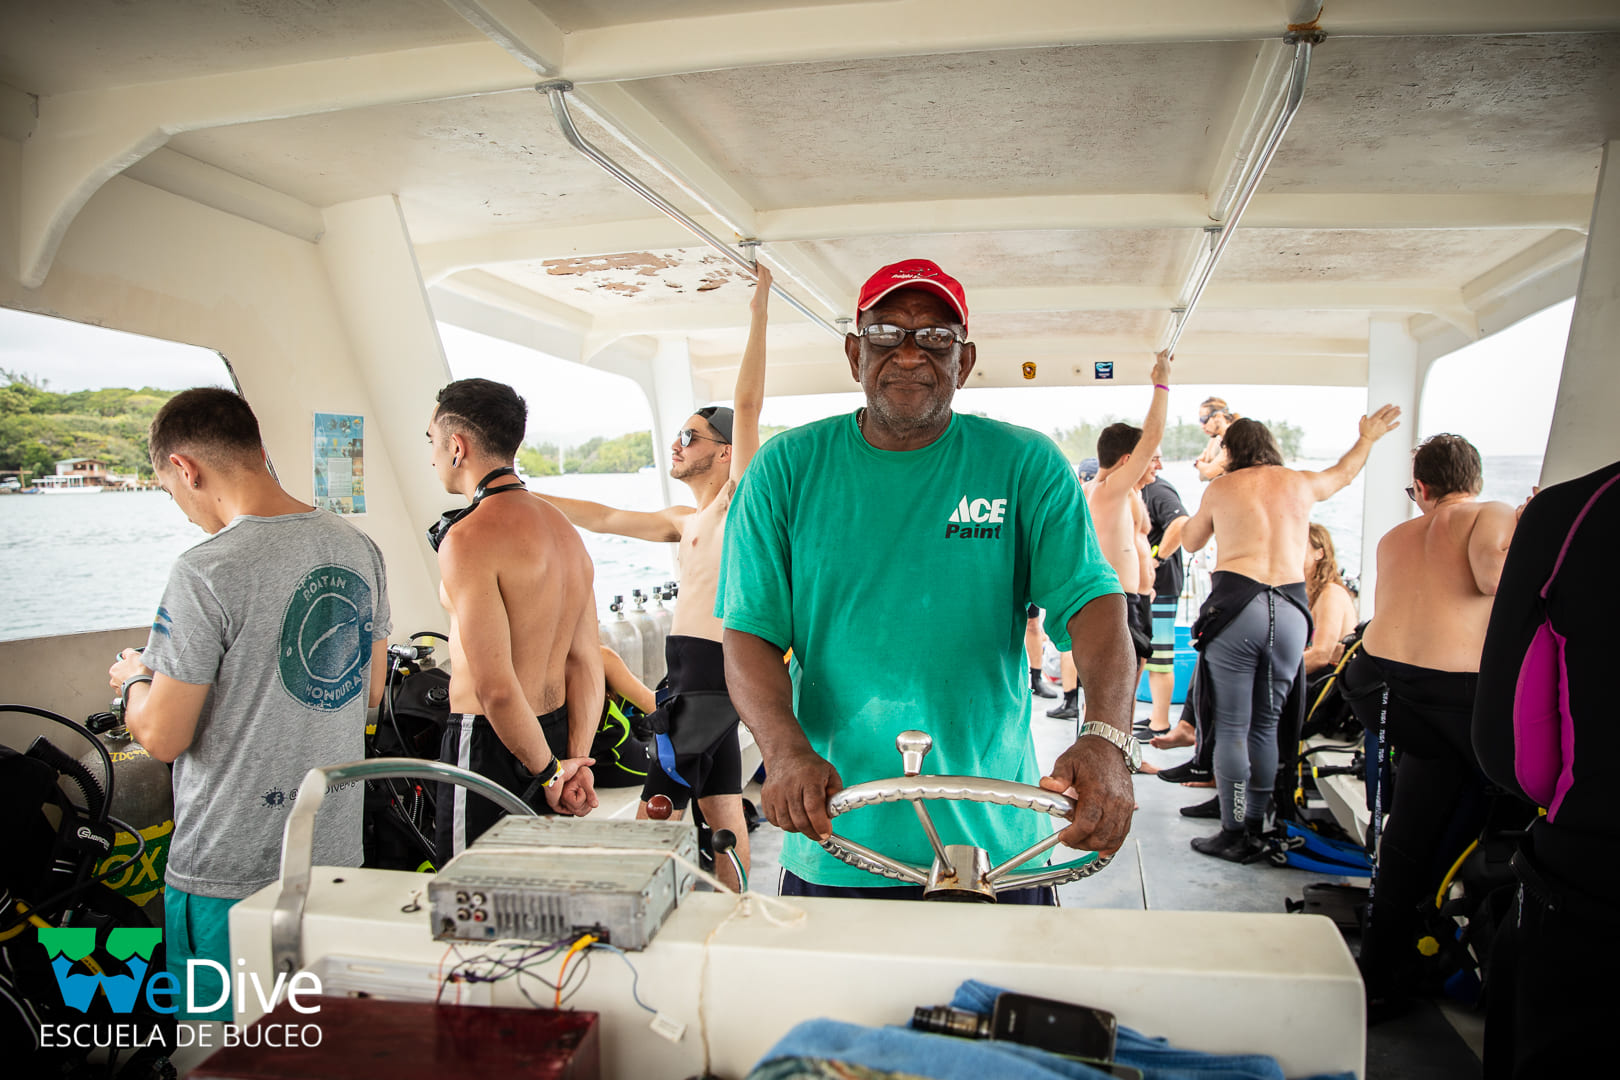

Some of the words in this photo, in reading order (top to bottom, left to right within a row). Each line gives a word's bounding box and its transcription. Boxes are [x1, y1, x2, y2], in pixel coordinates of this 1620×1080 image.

[948, 494, 1007, 523] ACE
[945, 524, 1002, 539] Paint
[303, 575, 347, 601] ROATAN
[305, 675, 363, 702] HONDURA
[92, 846, 162, 890] OX
